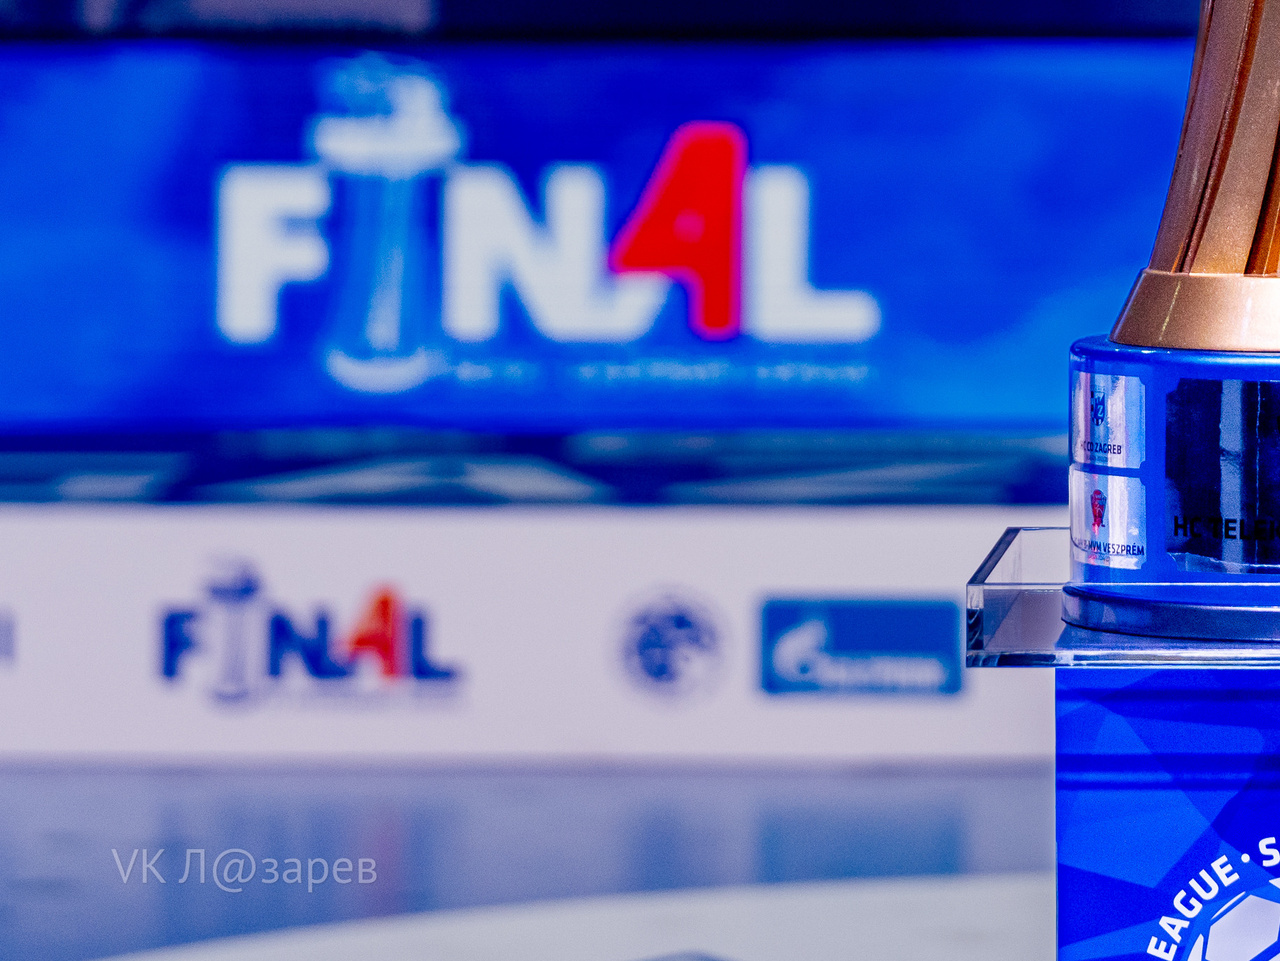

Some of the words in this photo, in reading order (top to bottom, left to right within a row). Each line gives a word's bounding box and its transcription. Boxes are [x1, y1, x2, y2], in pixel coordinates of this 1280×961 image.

[1095, 443, 1122, 454] ZAGREB
[1174, 516, 1202, 537] HC
[1103, 542, 1144, 555] VESZPRÉM
